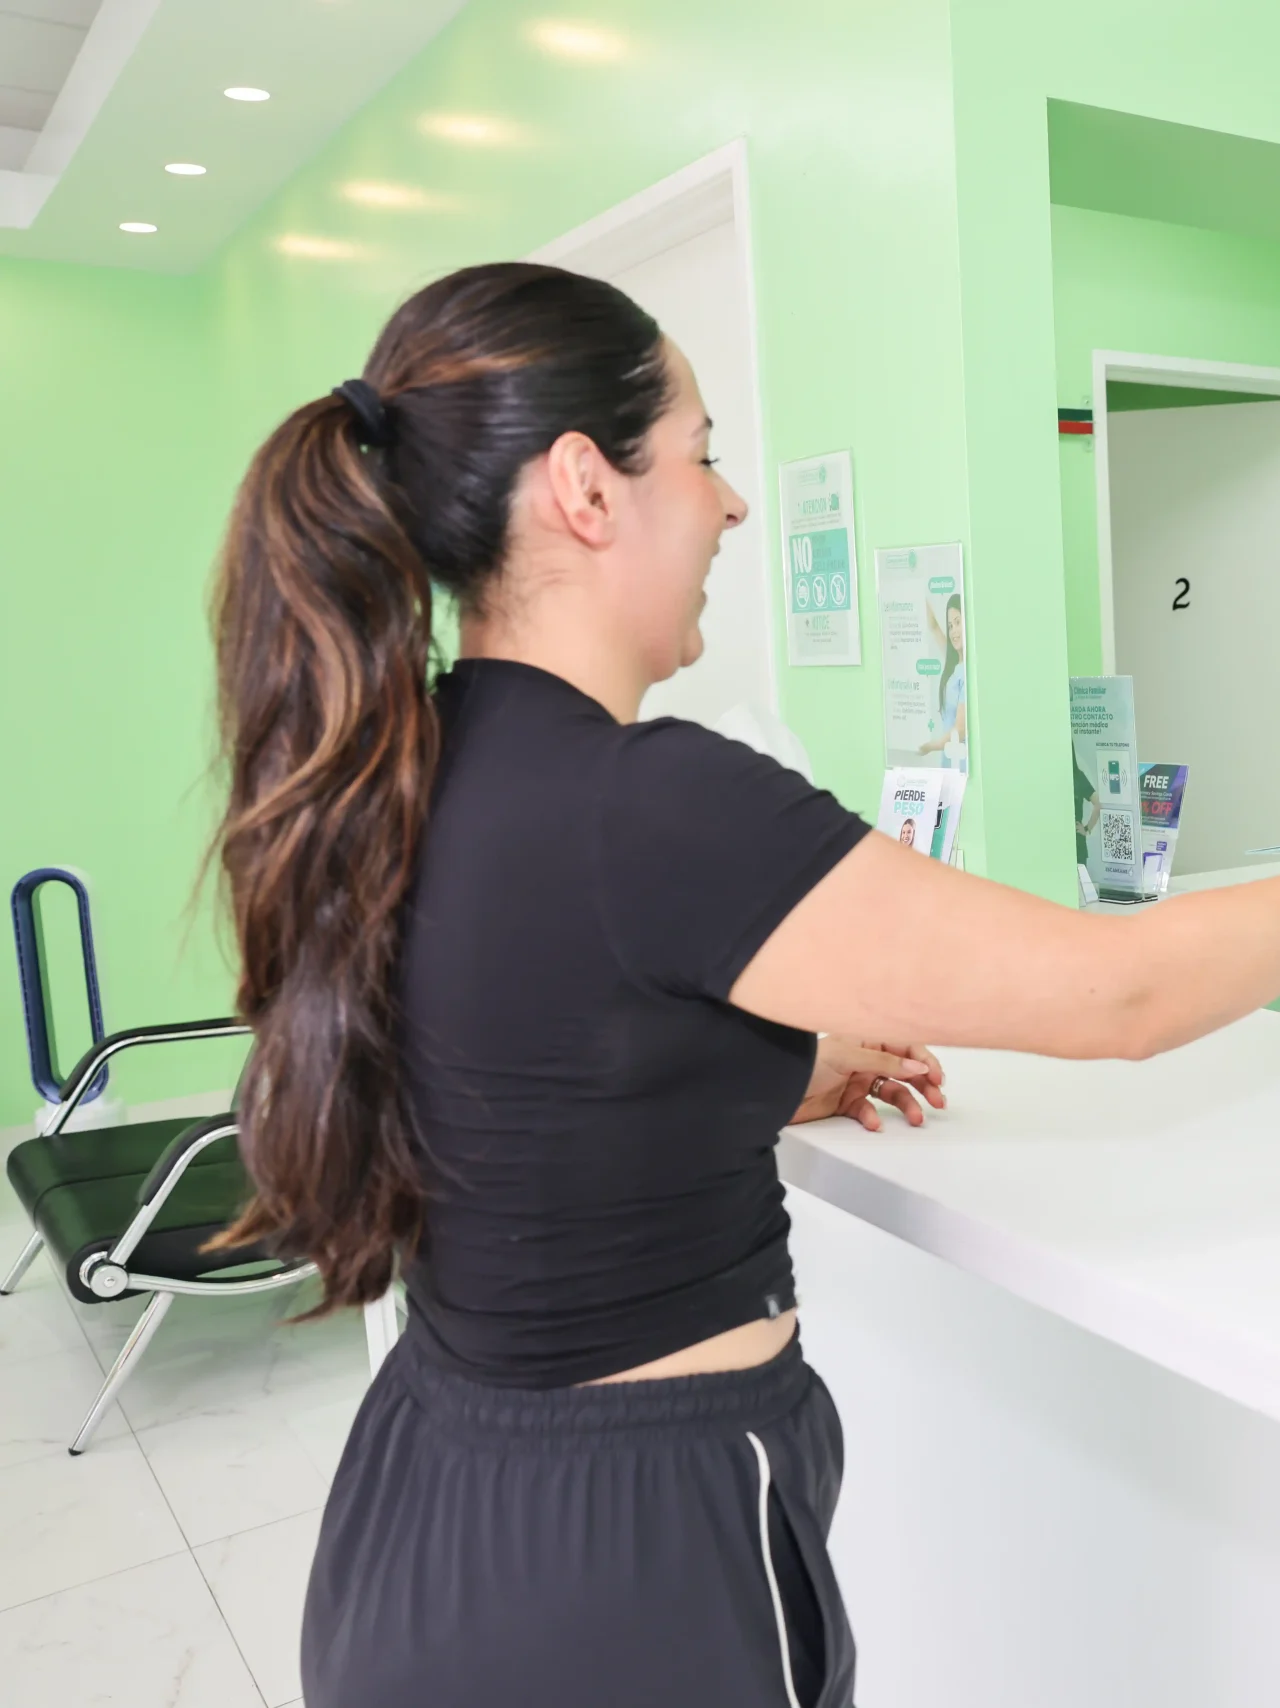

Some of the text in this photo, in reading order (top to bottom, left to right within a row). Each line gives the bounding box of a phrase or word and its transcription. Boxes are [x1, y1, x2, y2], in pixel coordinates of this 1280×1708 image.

[792, 535, 812, 574] NO
[1172, 577, 1191, 611] 2
[1143, 774, 1170, 789] FREE
[894, 789, 926, 801] PIERDE
[893, 801, 925, 816] PESO
